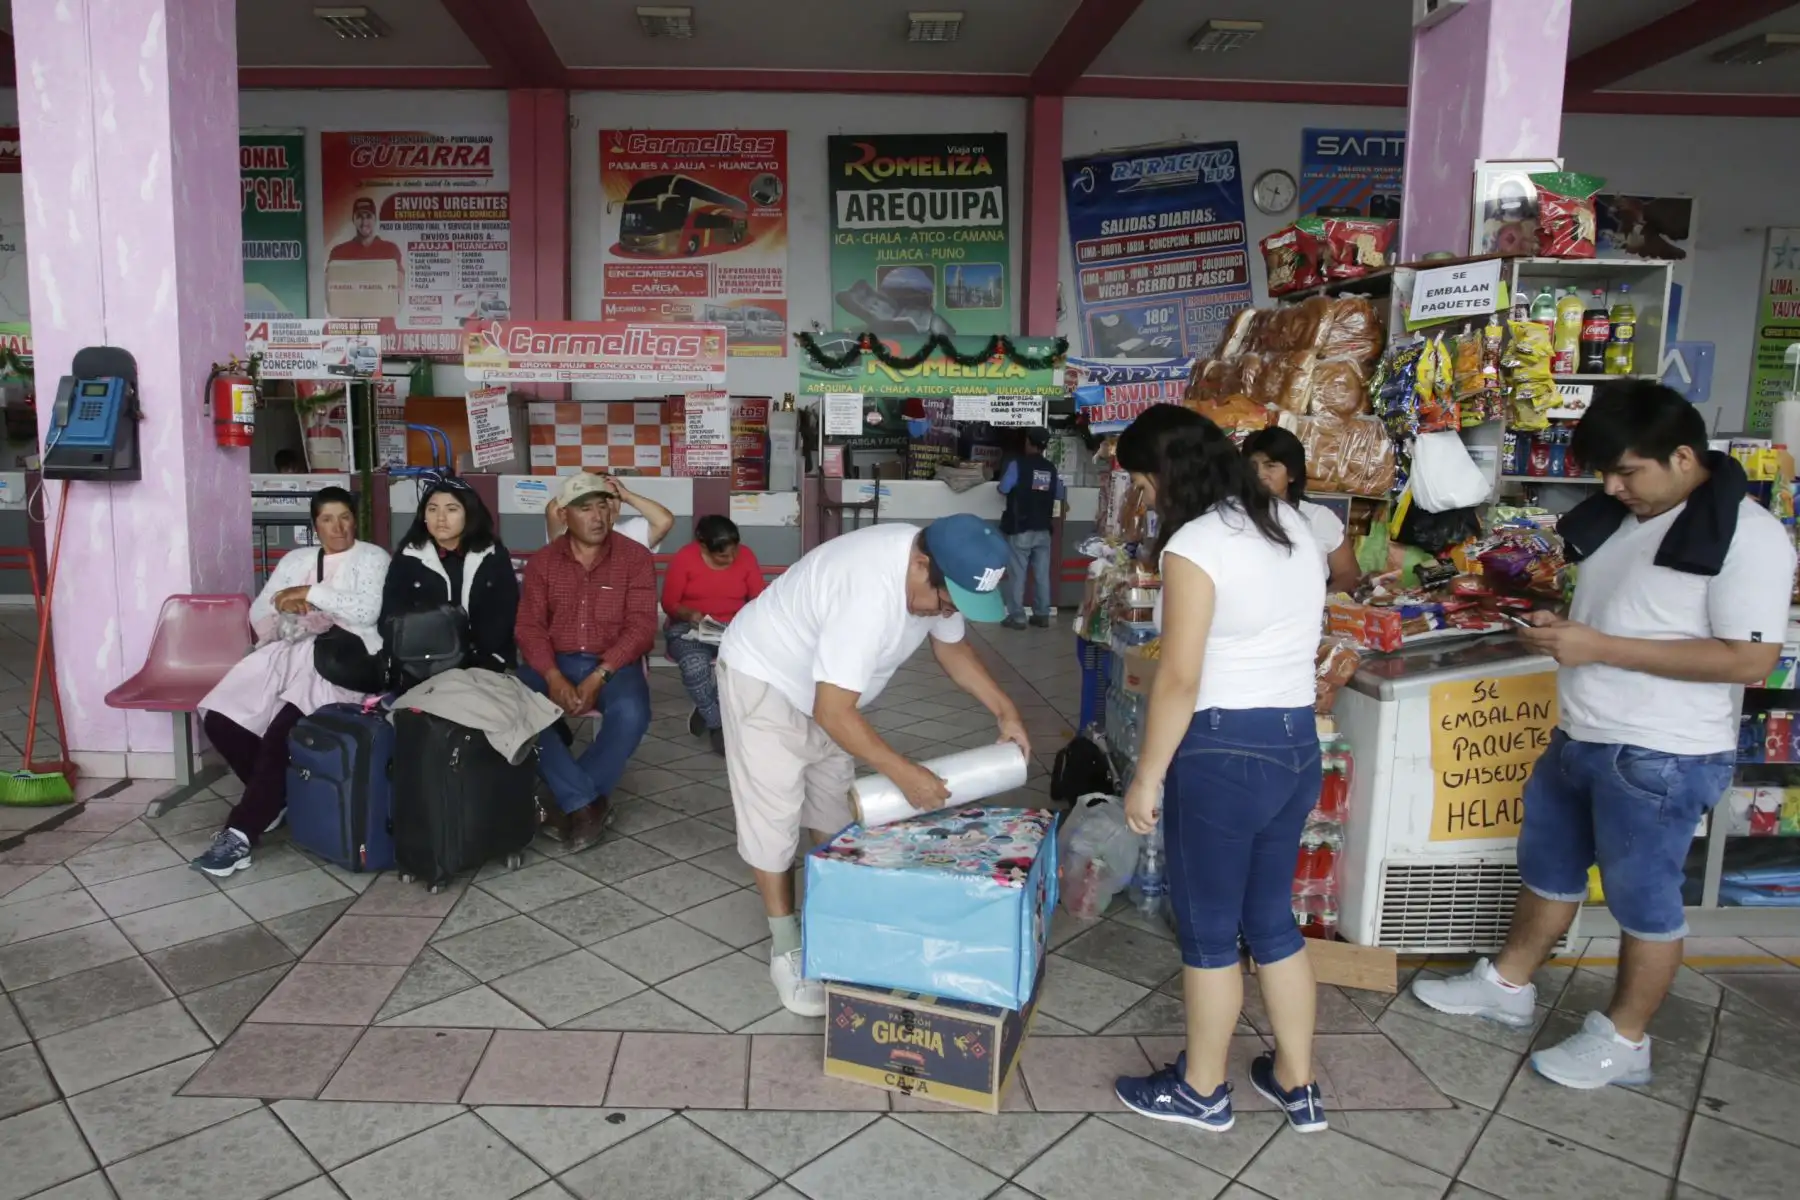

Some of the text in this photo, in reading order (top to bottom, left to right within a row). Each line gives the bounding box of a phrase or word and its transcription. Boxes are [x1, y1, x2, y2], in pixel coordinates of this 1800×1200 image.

[450, 136, 494, 144] PUNTUALIDAD
[627, 134, 775, 154] Carmelitas
[350, 144, 491, 168] GUTARRA
[973, 146, 985, 154] en
[608, 162, 779, 171] PASAJES A JAUJA HUANCAYO
[845, 142, 993, 184] ROMELIZA
[1204, 166, 1235, 183] BUS
[394, 196, 509, 210] ENVIOS URGENTES
[845, 191, 999, 224] AREQUIPA
[1101, 208, 1216, 235] SALIDAS DIARIAS:
[420, 233, 450, 241] ENVÍOS
[453, 233, 484, 241] DIARIOS
[835, 230, 1005, 245] ICA CHALA ATICO CAMANA
[1081, 247, 1097, 260] LIMA
[1194, 227, 1240, 245] HUANCAYO
[242, 241, 302, 260] HUANCAYO
[876, 247, 966, 261] JULIACA PUNO
[608, 269, 704, 278] ENCOMIENDAS
[1452, 271, 1468, 280] SE
[631, 284, 681, 293] CARGA
[1098, 269, 1235, 298] VICCO CERRO DE PASCO
[1427, 283, 1490, 298] EMBALAN
[1770, 279, 1793, 296] LIMA
[1421, 298, 1491, 313] PAQUETES
[508, 327, 701, 358] Carmelitas
[262, 360, 319, 370] CONCEPCION
[593, 362, 653, 370] CONCEPCION
[660, 363, 713, 371] HUANCAYO
[867, 341, 1027, 383] RMELIZA
[806, 384, 1064, 396] AREQUIPA ICA CHALA ATICO CAMANA JULIACA PUNO
[922, 399, 946, 409] Lima
[1472, 680, 1500, 704] SE
[1441, 699, 1552, 732] EMBALAN
[1452, 727, 1550, 762] PAQUETE
[1447, 798, 1524, 834] HELAD
[872, 1020, 945, 1059] GLORIA
[884, 1073, 929, 1094] CAA
